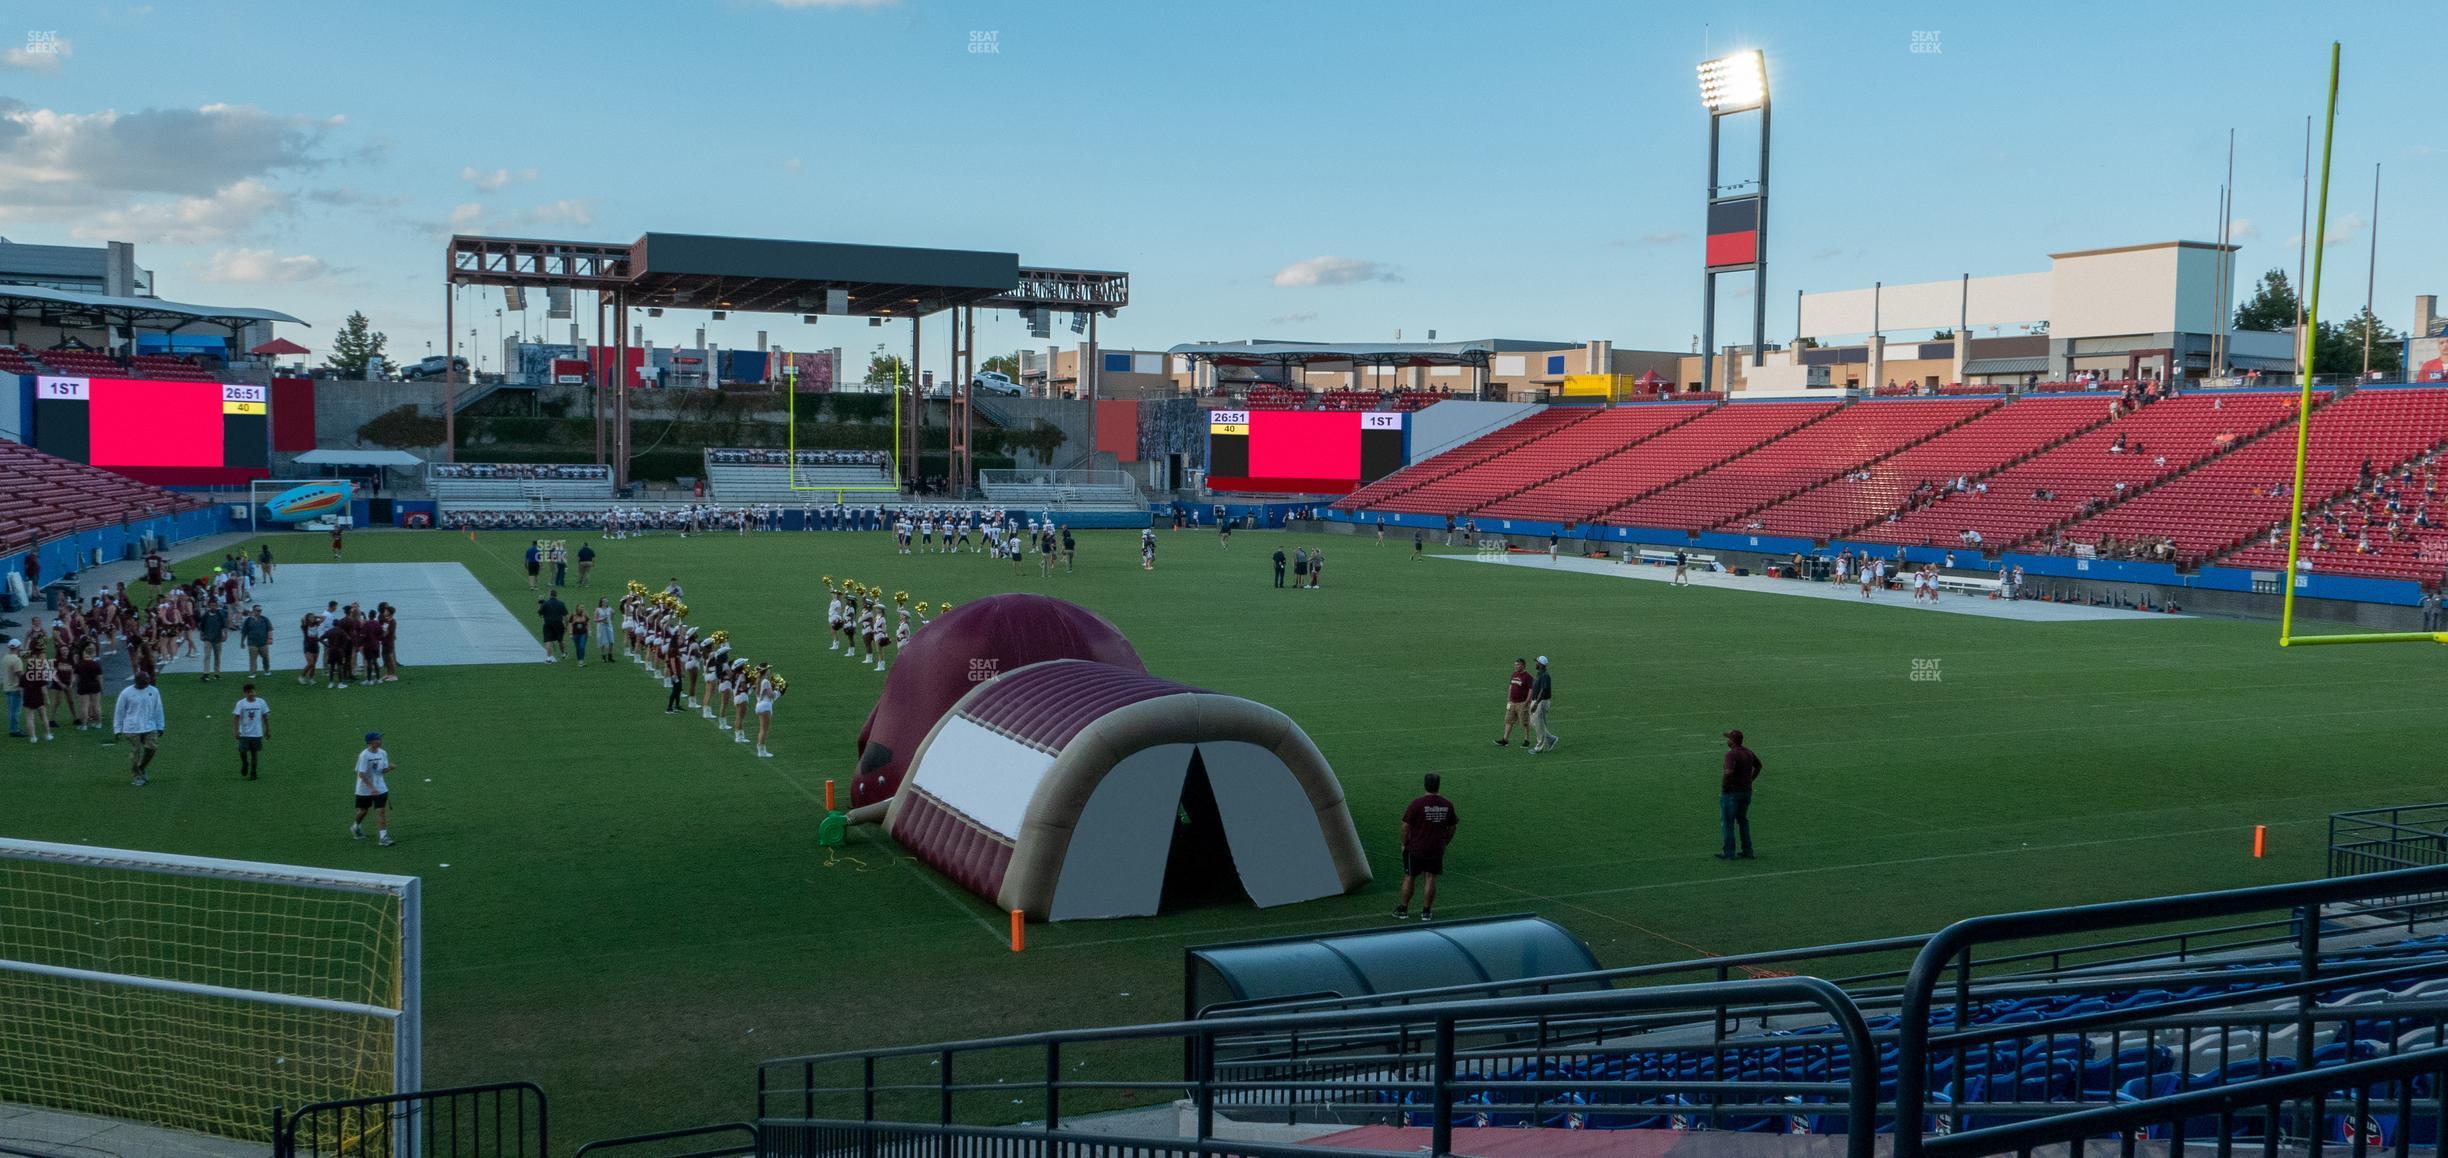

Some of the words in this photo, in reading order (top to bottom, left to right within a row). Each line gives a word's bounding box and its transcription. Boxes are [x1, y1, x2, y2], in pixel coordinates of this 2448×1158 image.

[50, 382, 80, 395] 1ST
[226, 387, 260, 400] 26:51
[237, 403, 250, 412] 40
[1214, 412, 1245, 422] 26:51
[1369, 416, 1393, 426] 1ST
[1223, 425, 1235, 433] 40
